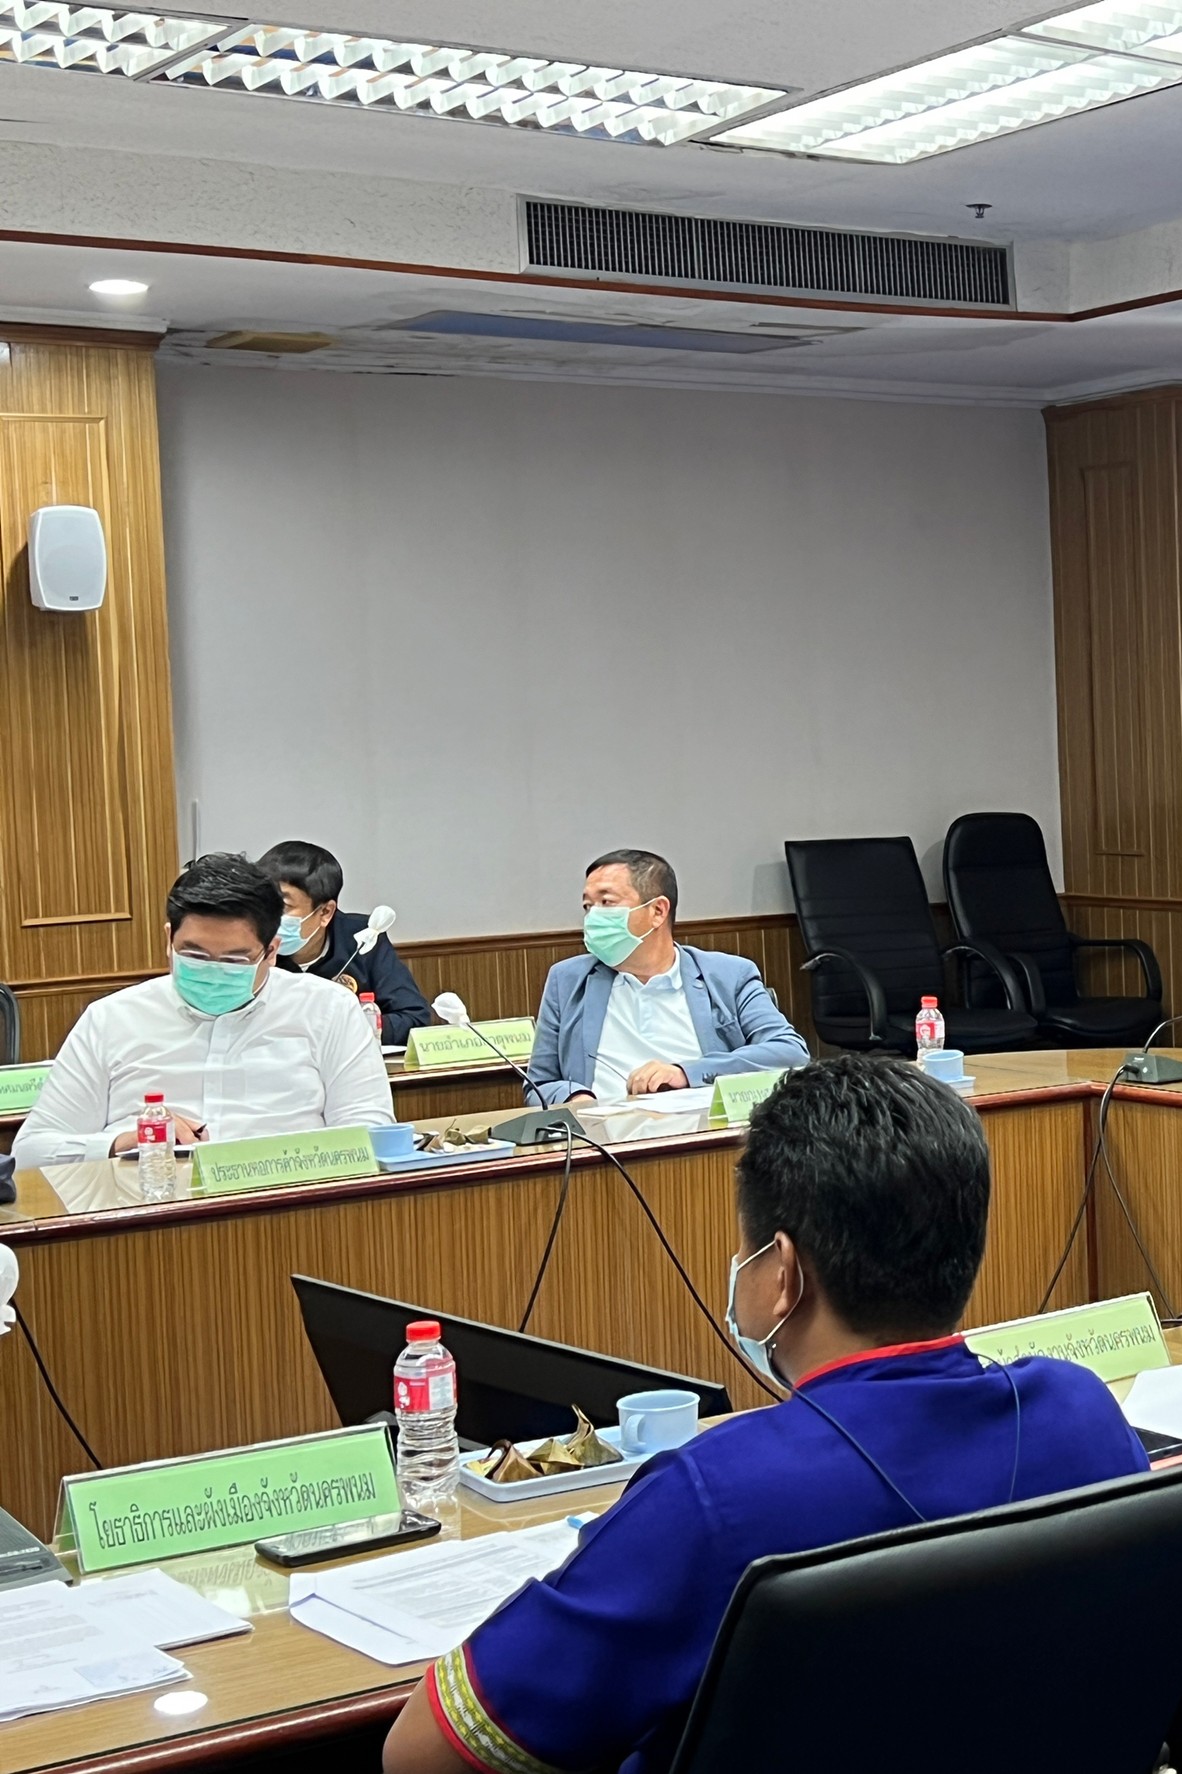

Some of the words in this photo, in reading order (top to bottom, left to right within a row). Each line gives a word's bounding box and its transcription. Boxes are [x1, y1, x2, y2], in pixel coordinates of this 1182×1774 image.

[419, 1032, 531, 1052] นายอำเภอาตุพนม
[211, 1145, 370, 1183] ประธานหอการค้าจังหวัดนครพนม
[88, 1472, 377, 1550] โยธาธิการและผังเมืองจังหวัดนครพนม
